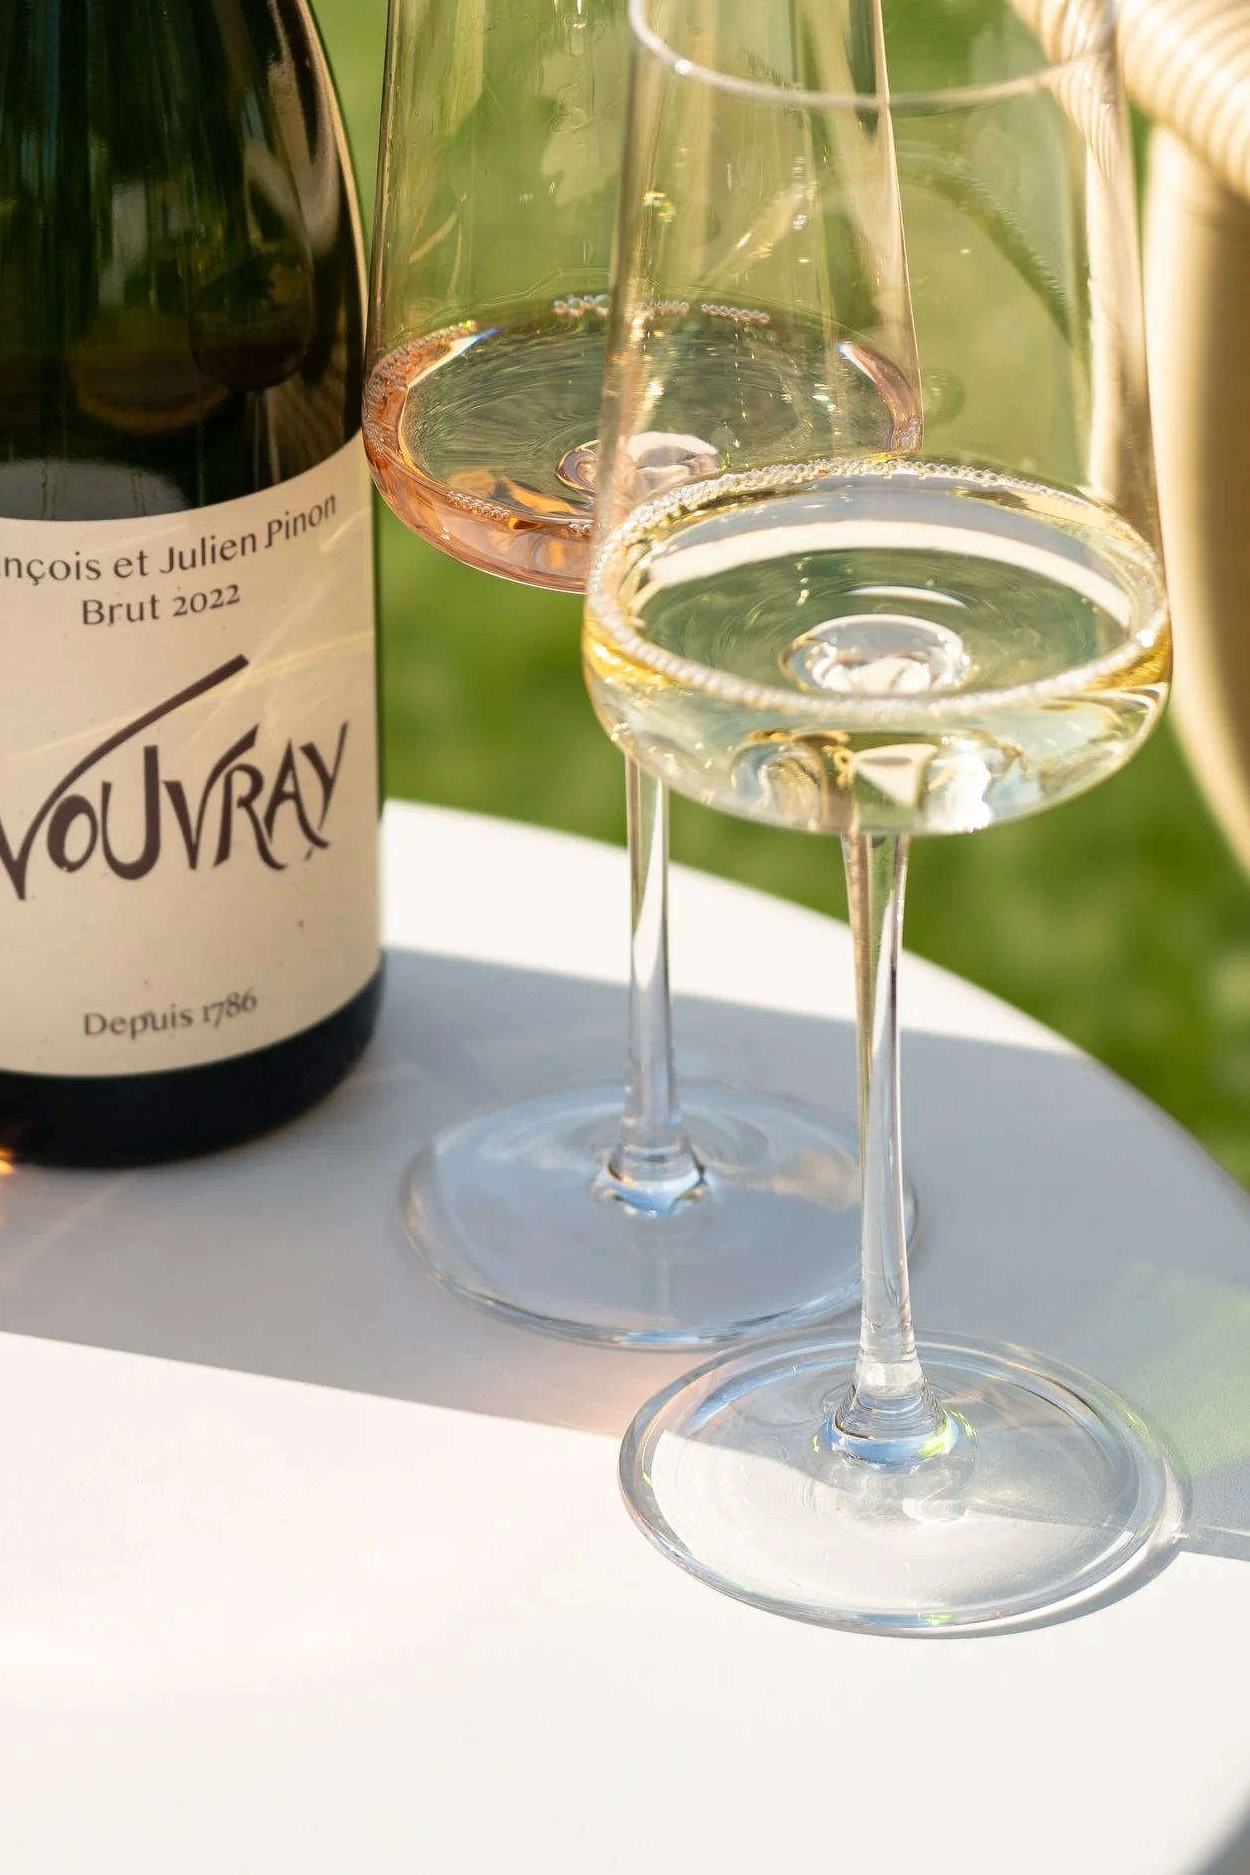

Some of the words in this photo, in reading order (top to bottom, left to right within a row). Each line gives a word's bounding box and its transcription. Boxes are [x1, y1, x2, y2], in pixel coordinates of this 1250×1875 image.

[113, 550, 149, 578] et
[159, 531, 257, 575] Julien
[264, 493, 337, 550] Pinon
[82, 593, 161, 626] Brut
[172, 583, 241, 617] 2022
[83, 1003, 194, 1041] Depuis
[202, 986, 258, 1030] 1786
